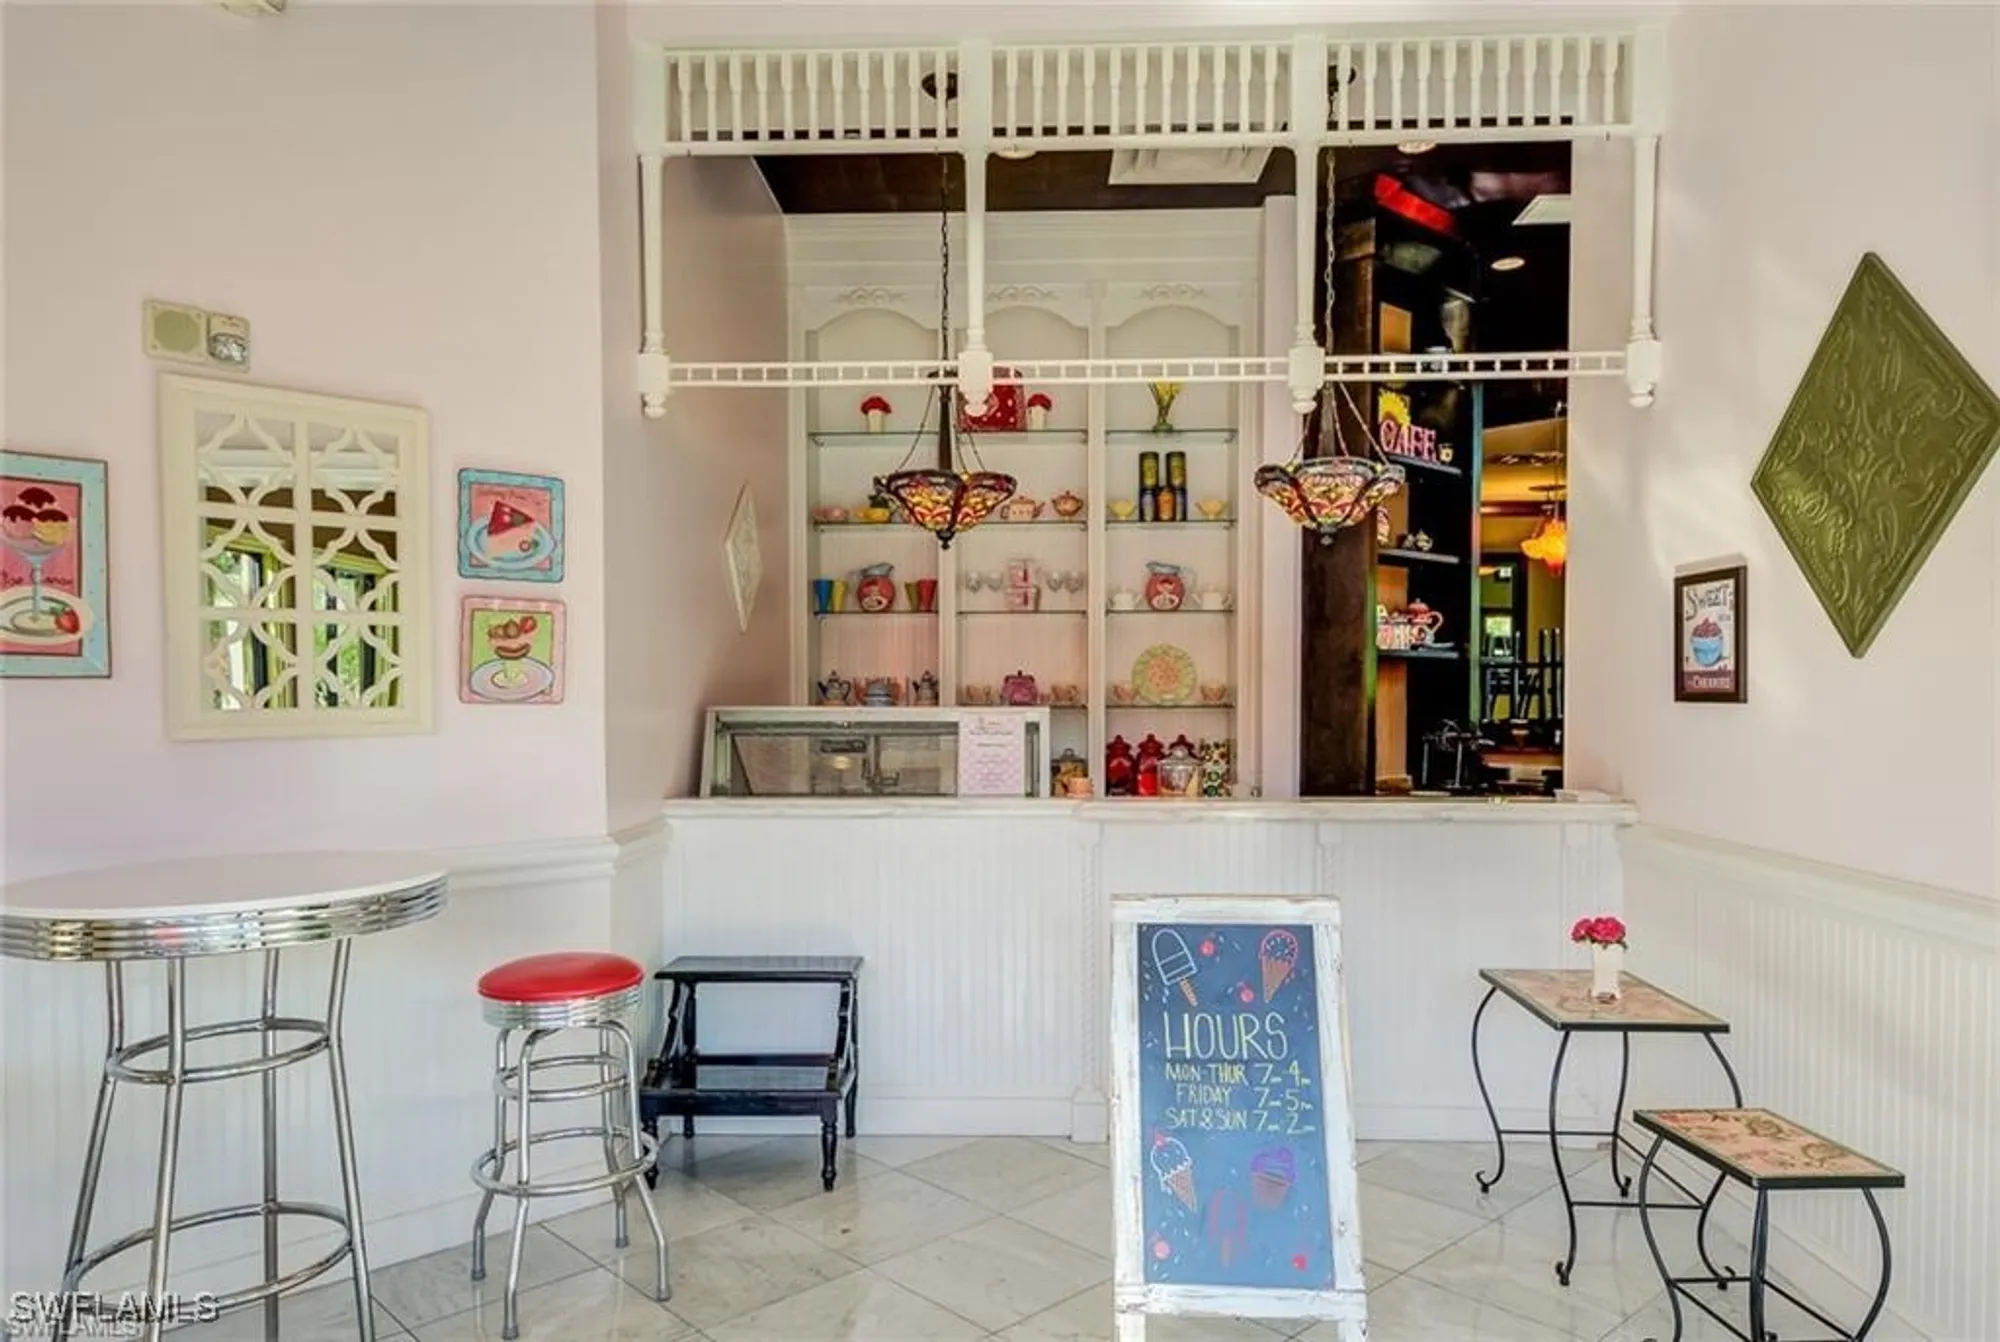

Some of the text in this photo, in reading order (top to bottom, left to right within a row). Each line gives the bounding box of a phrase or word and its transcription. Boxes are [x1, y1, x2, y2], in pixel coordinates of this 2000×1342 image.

[1380, 419, 1437, 463] CAFE
[1163, 1011, 1289, 1061] HOURS
[1176, 1083, 1233, 1107] FRIDAY
